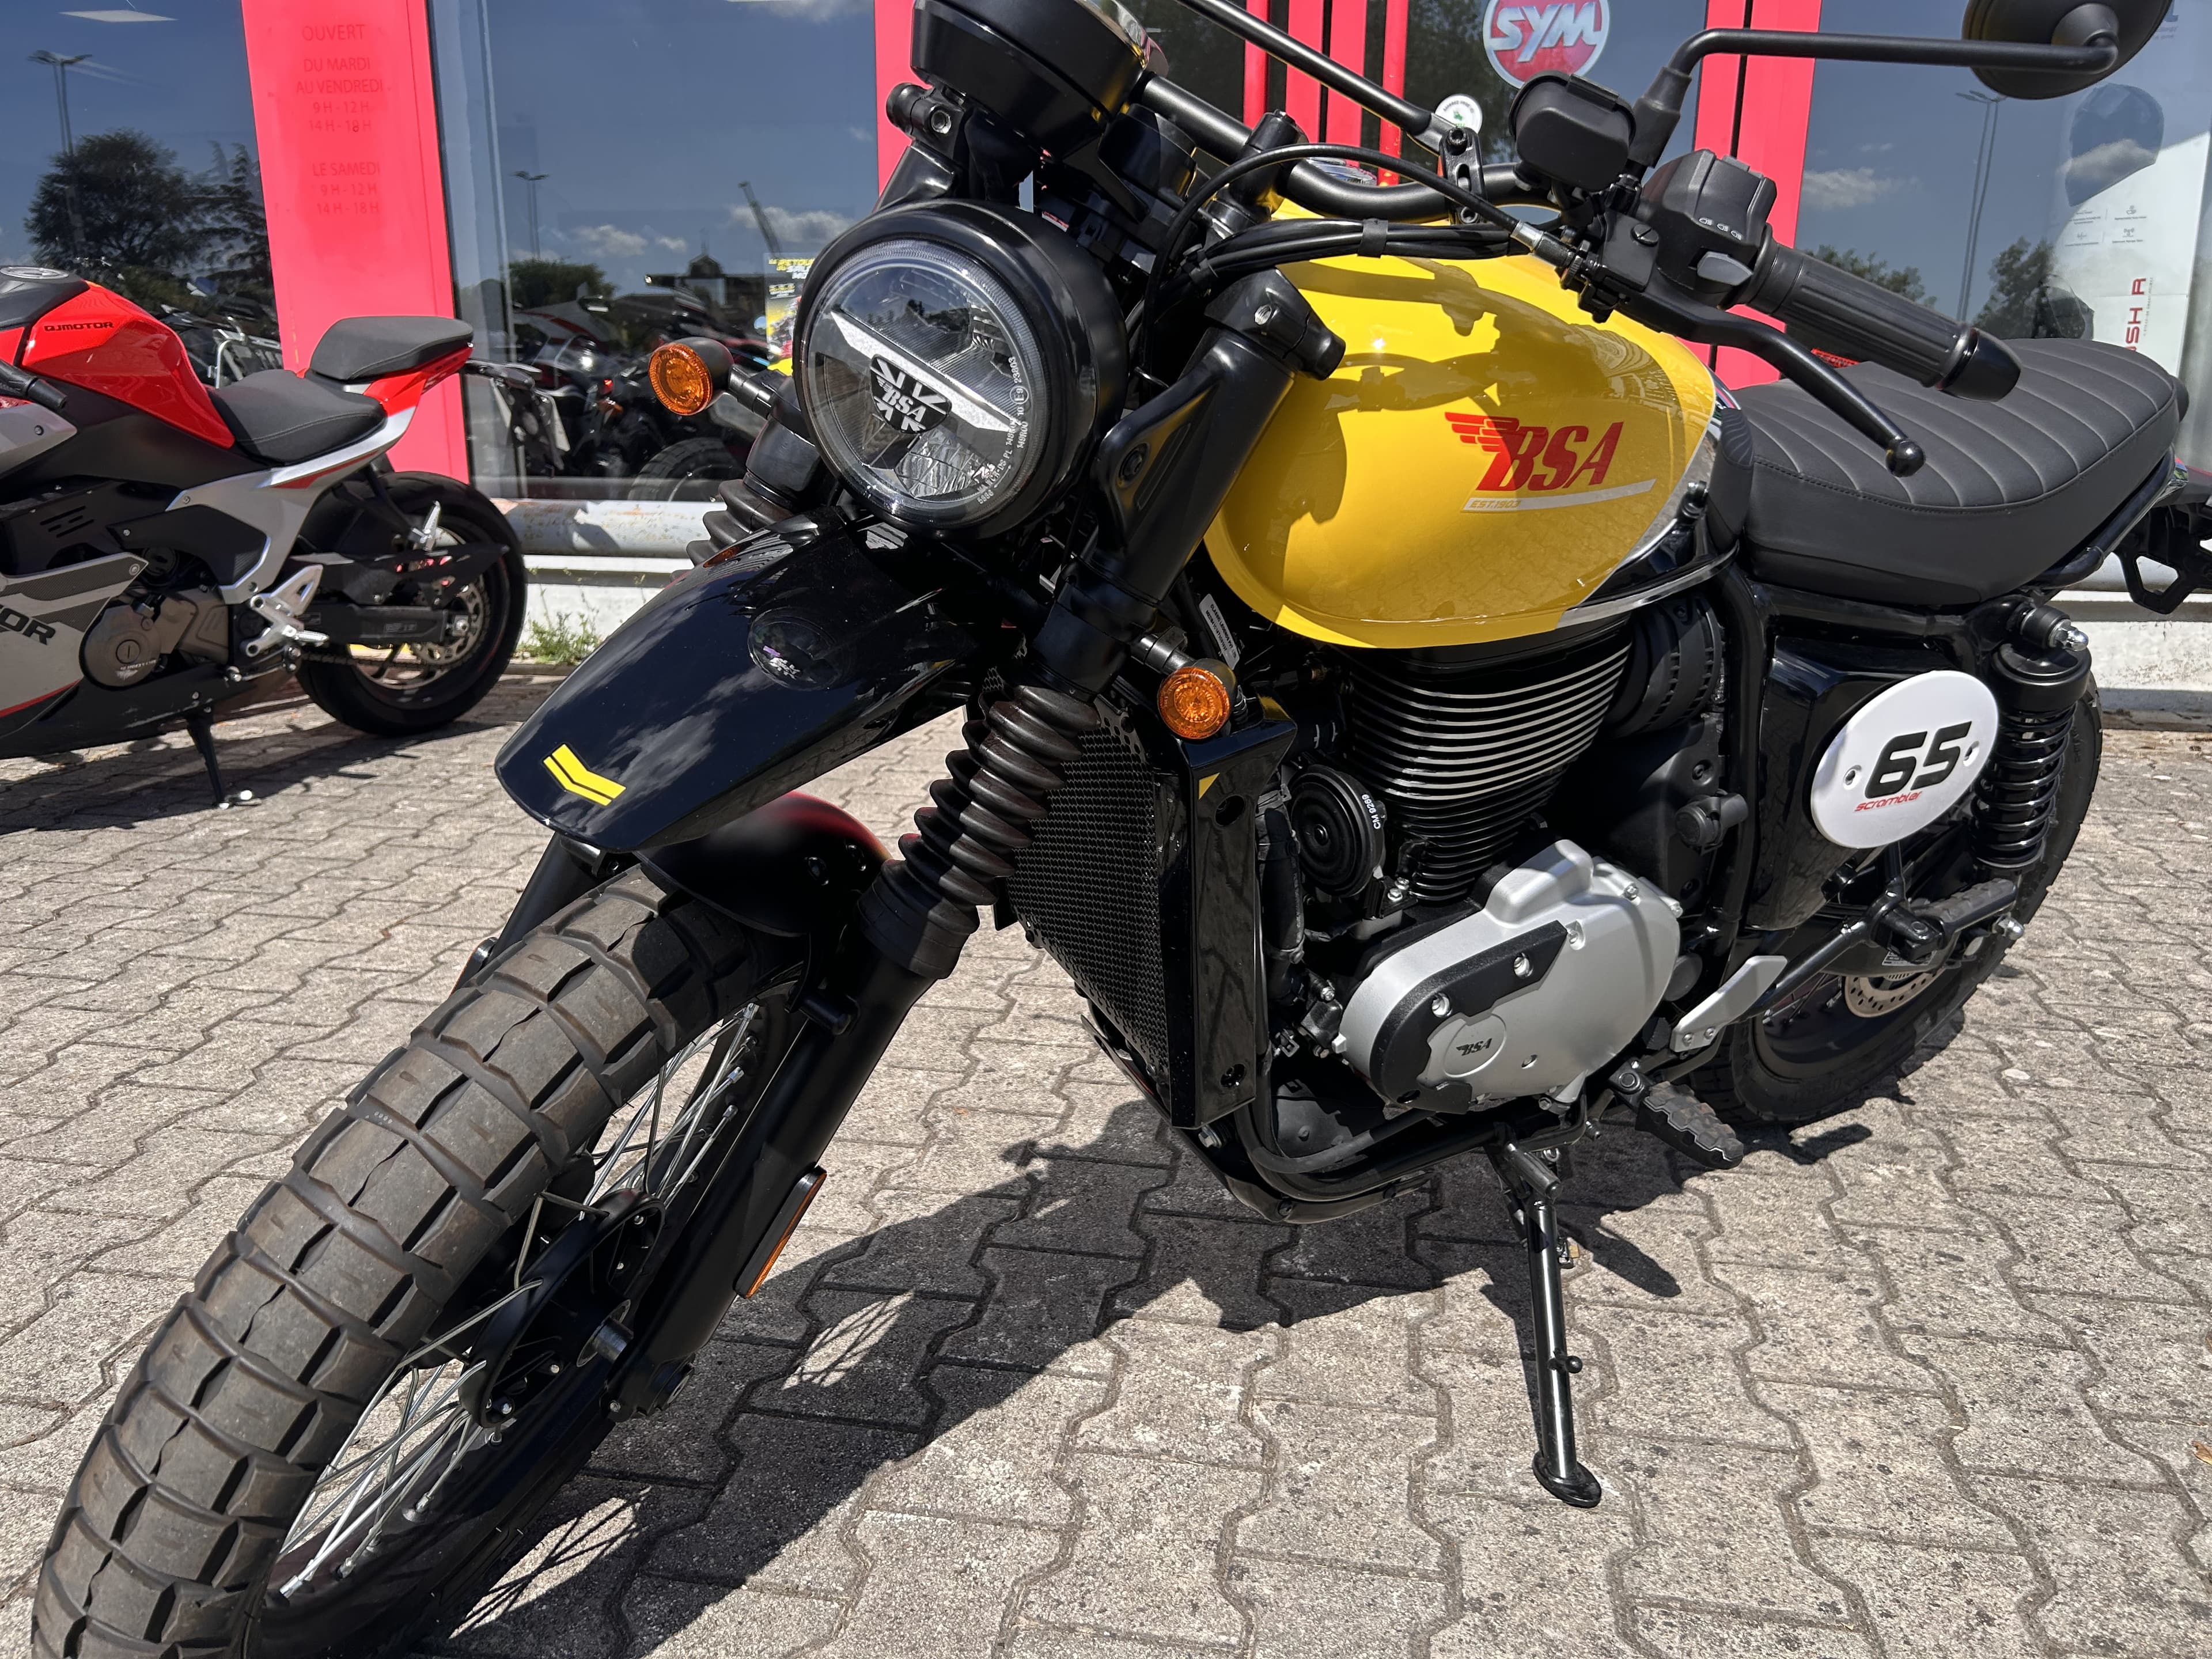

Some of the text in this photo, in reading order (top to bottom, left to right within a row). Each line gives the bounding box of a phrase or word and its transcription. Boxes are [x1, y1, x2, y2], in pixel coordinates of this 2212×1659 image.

[301, 24, 365, 41] OUVERT
[1490, 2, 1603, 63] SYM
[304, 56, 371, 72] DU MARDI
[296, 79, 383, 94] AU VENDREDI
[312, 161, 381, 177] LE SAMEDI
[44, 321, 114, 331] QJMOTOR
[2124, 307, 2143, 351] SH
[1008, 356, 1022, 384] 23803
[882, 389, 926, 422] BSA
[1017, 406, 1024, 416] 10
[1017, 421, 1028, 448] 149R00
[1003, 449, 1013, 459] PL
[1475, 421, 1624, 491] BSA
[1469, 499, 1521, 509] EST.1903
[0, 604, 56, 646] OR
[1865, 721, 1972, 799] 65
[1362, 794, 1381, 830] CM 9269
[1853, 791, 1923, 813] scrambler
[1461, 1038, 1492, 1056] BSA
